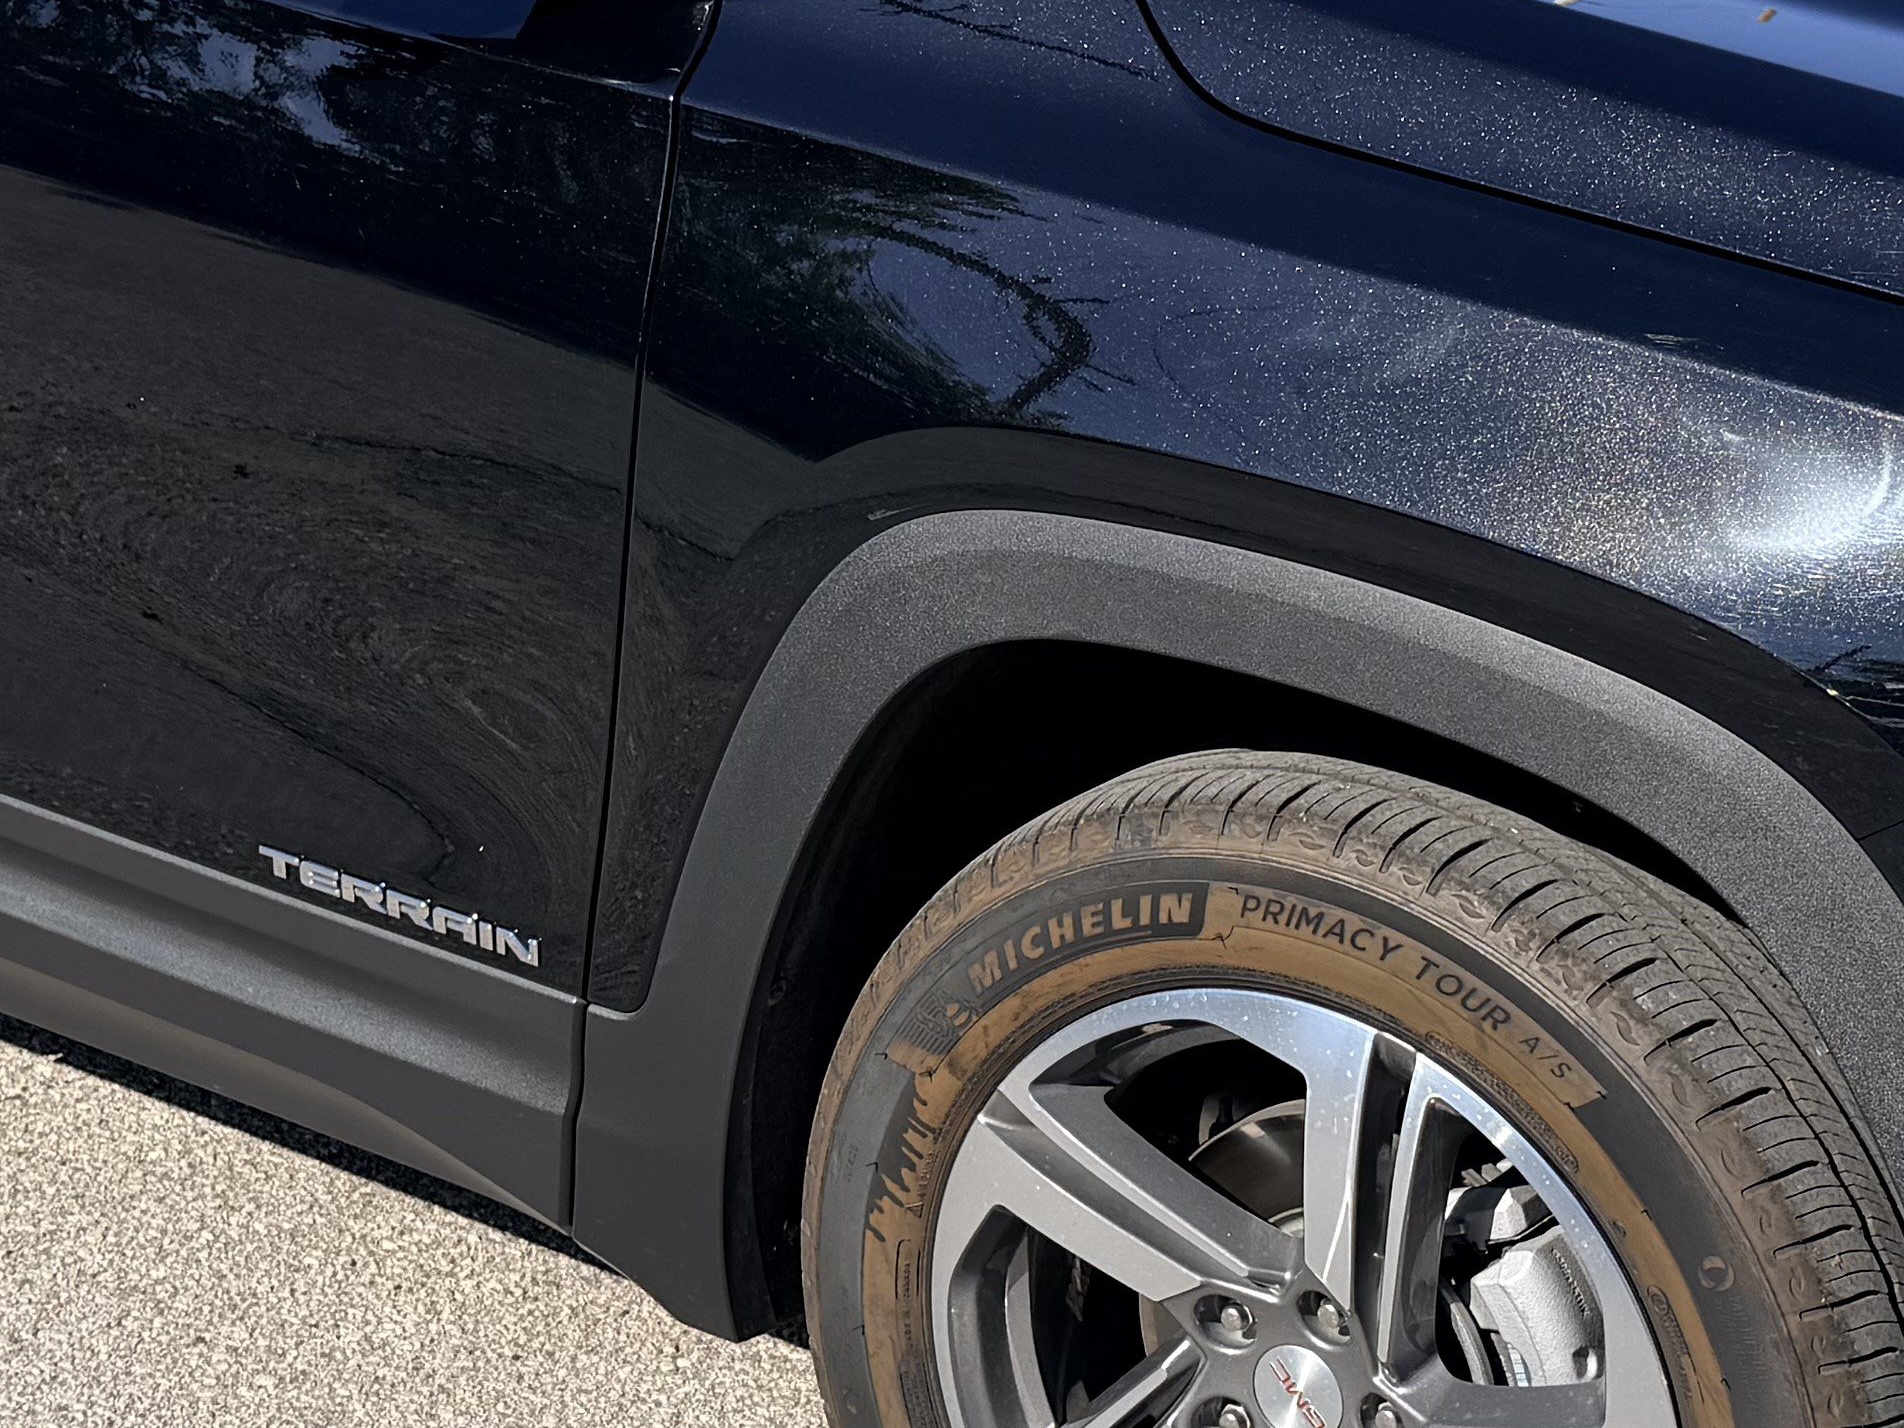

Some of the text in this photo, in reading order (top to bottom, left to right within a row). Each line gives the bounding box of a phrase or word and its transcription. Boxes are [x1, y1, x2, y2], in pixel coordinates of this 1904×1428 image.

[258, 844, 539, 967] TERRAIN
[969, 892, 1193, 993] MICHELIN
[1240, 894, 1573, 1080] PRIMACY TOUR A/S
